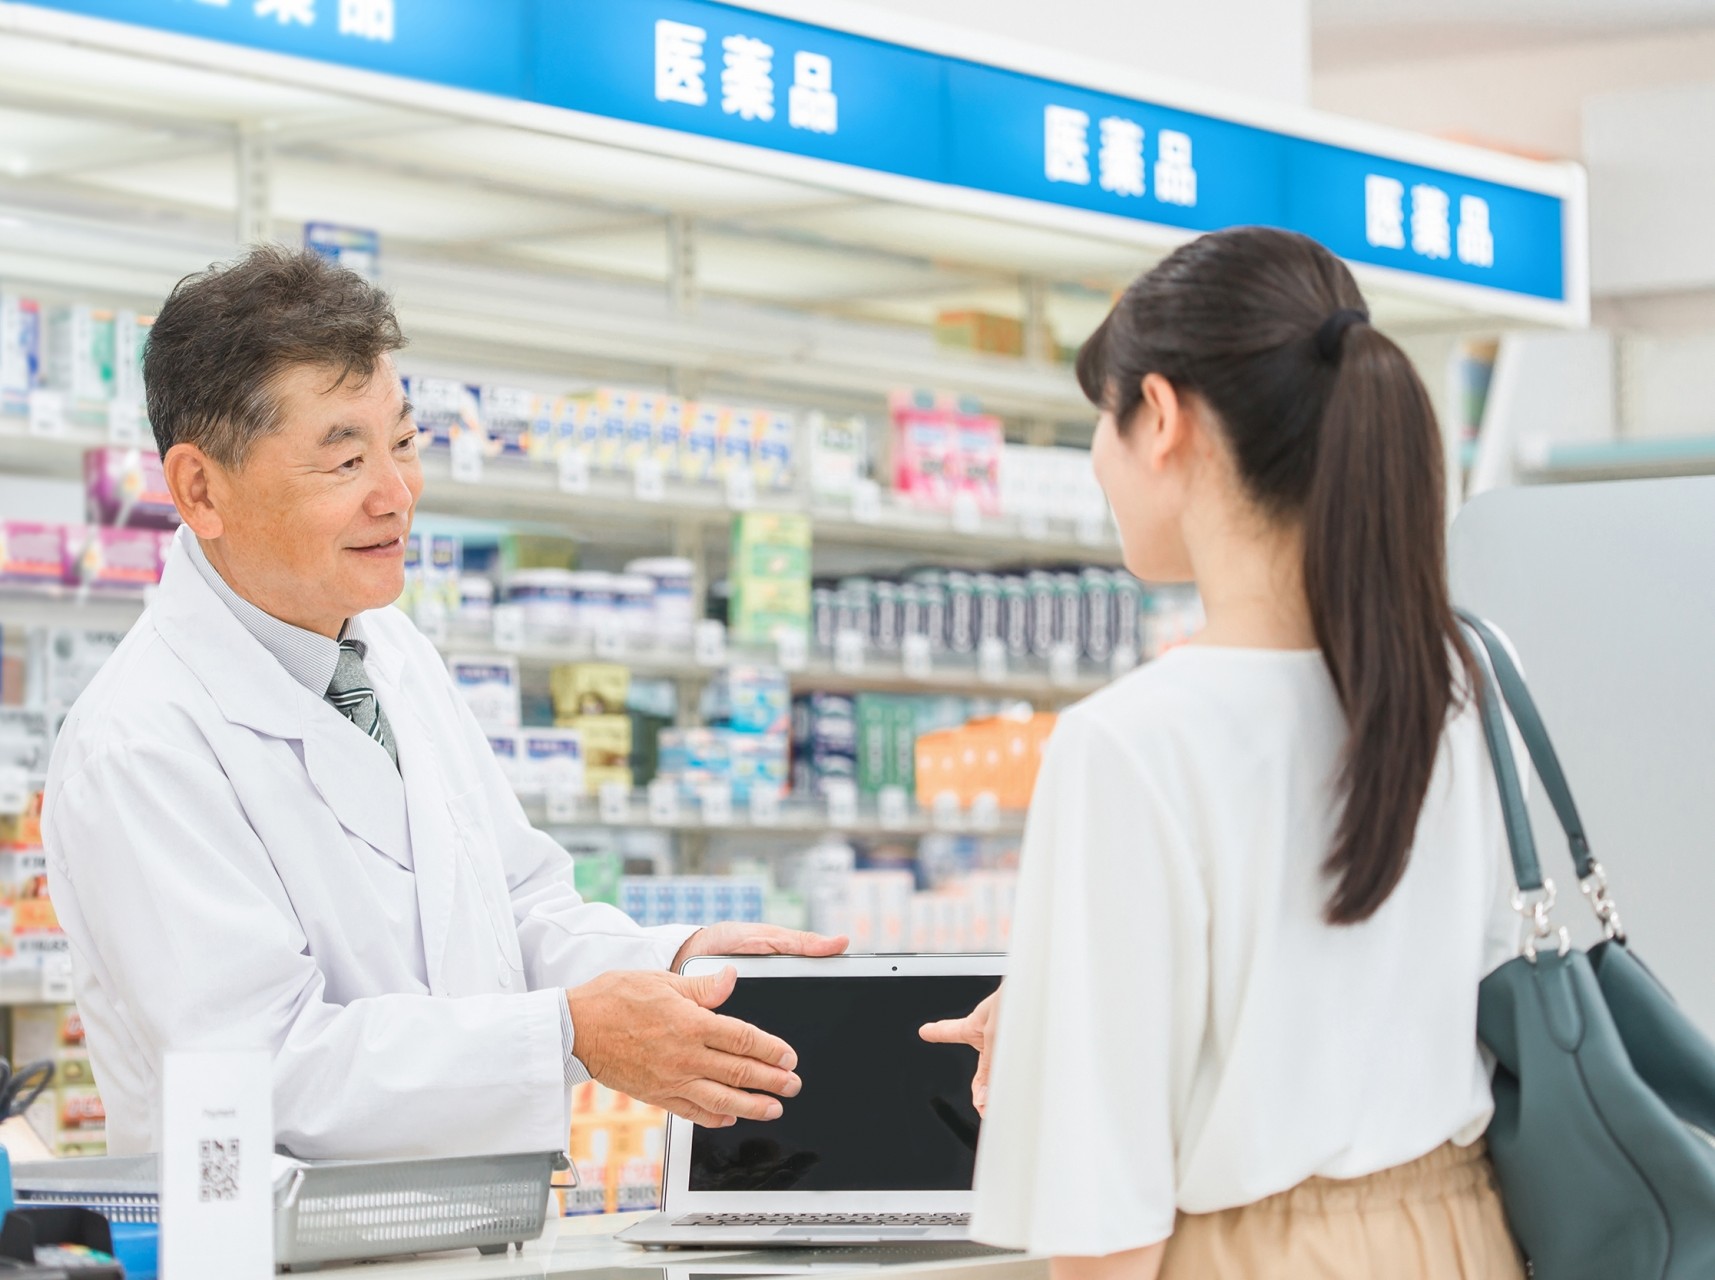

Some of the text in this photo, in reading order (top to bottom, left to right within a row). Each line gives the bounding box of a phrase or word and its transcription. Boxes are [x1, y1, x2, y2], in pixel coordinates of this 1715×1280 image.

[653, 18, 839, 135] 医薬品
[1043, 103, 1197, 206] 医薬品
[1364, 174, 1494, 267] 医薬品
